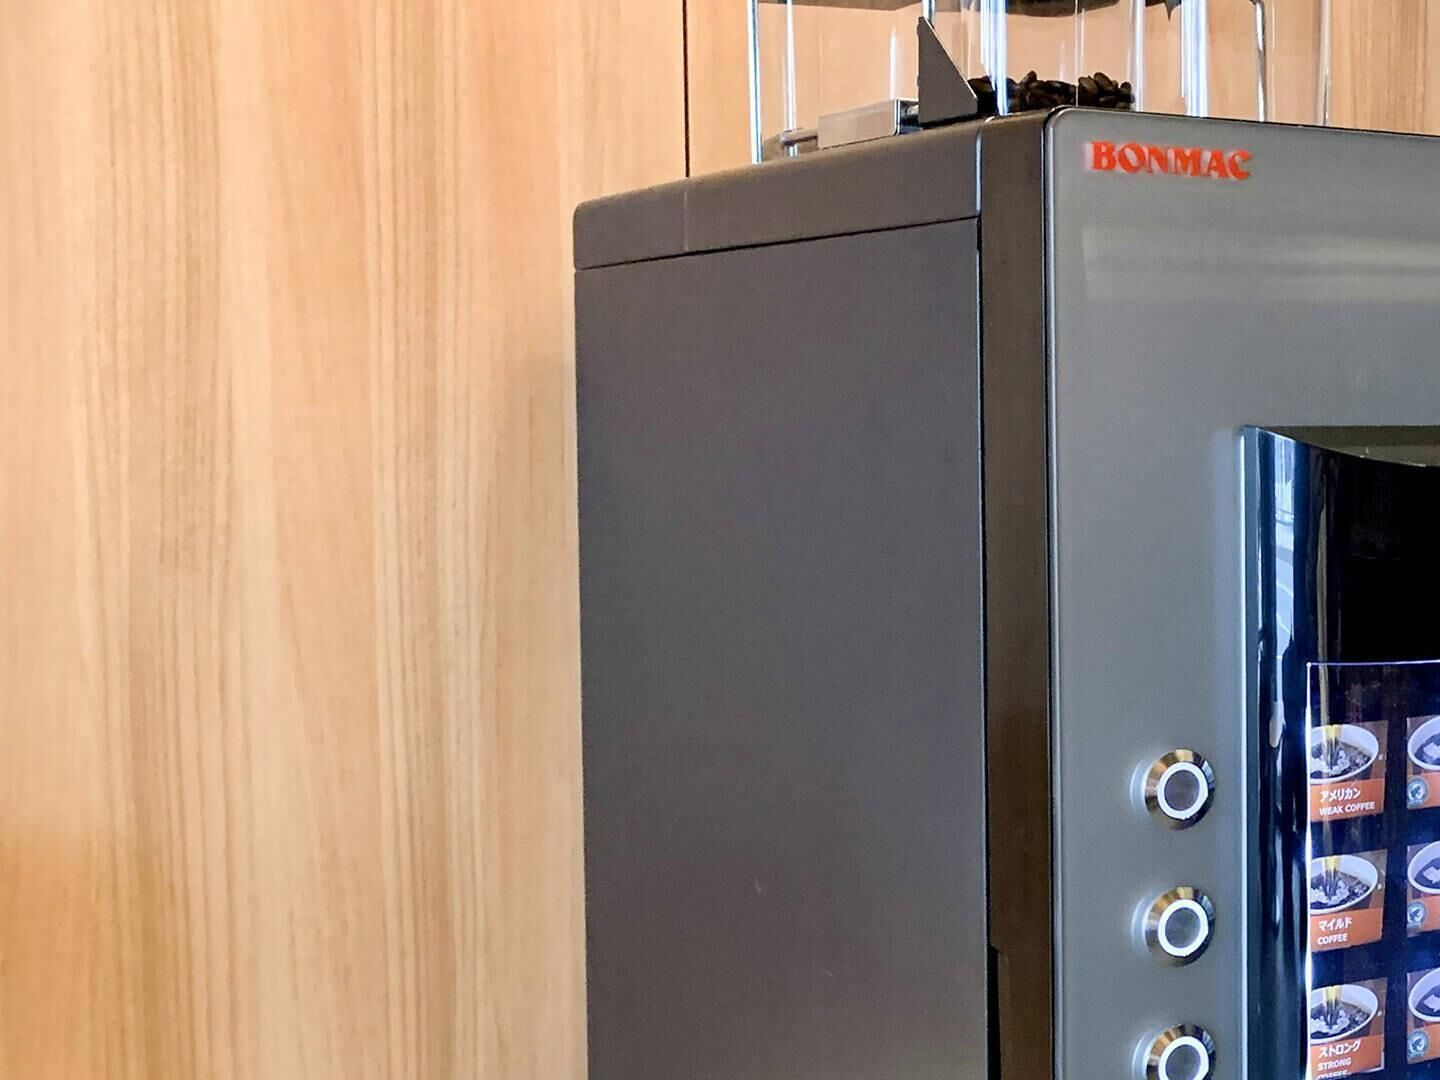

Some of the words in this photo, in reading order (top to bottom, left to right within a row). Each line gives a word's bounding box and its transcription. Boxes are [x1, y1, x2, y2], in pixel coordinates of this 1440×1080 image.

[1091, 141, 1252, 180] BONMAC
[1320, 787, 1362, 804] アメリカン
[1318, 805, 1343, 817] WEAK
[1344, 801, 1376, 814] COFFEE
[1318, 916, 1353, 933] マイルド
[1317, 933, 1348, 946] COFFEE
[1318, 1039, 1361, 1059] ストロング
[1317, 1057, 1352, 1072] STRONG
